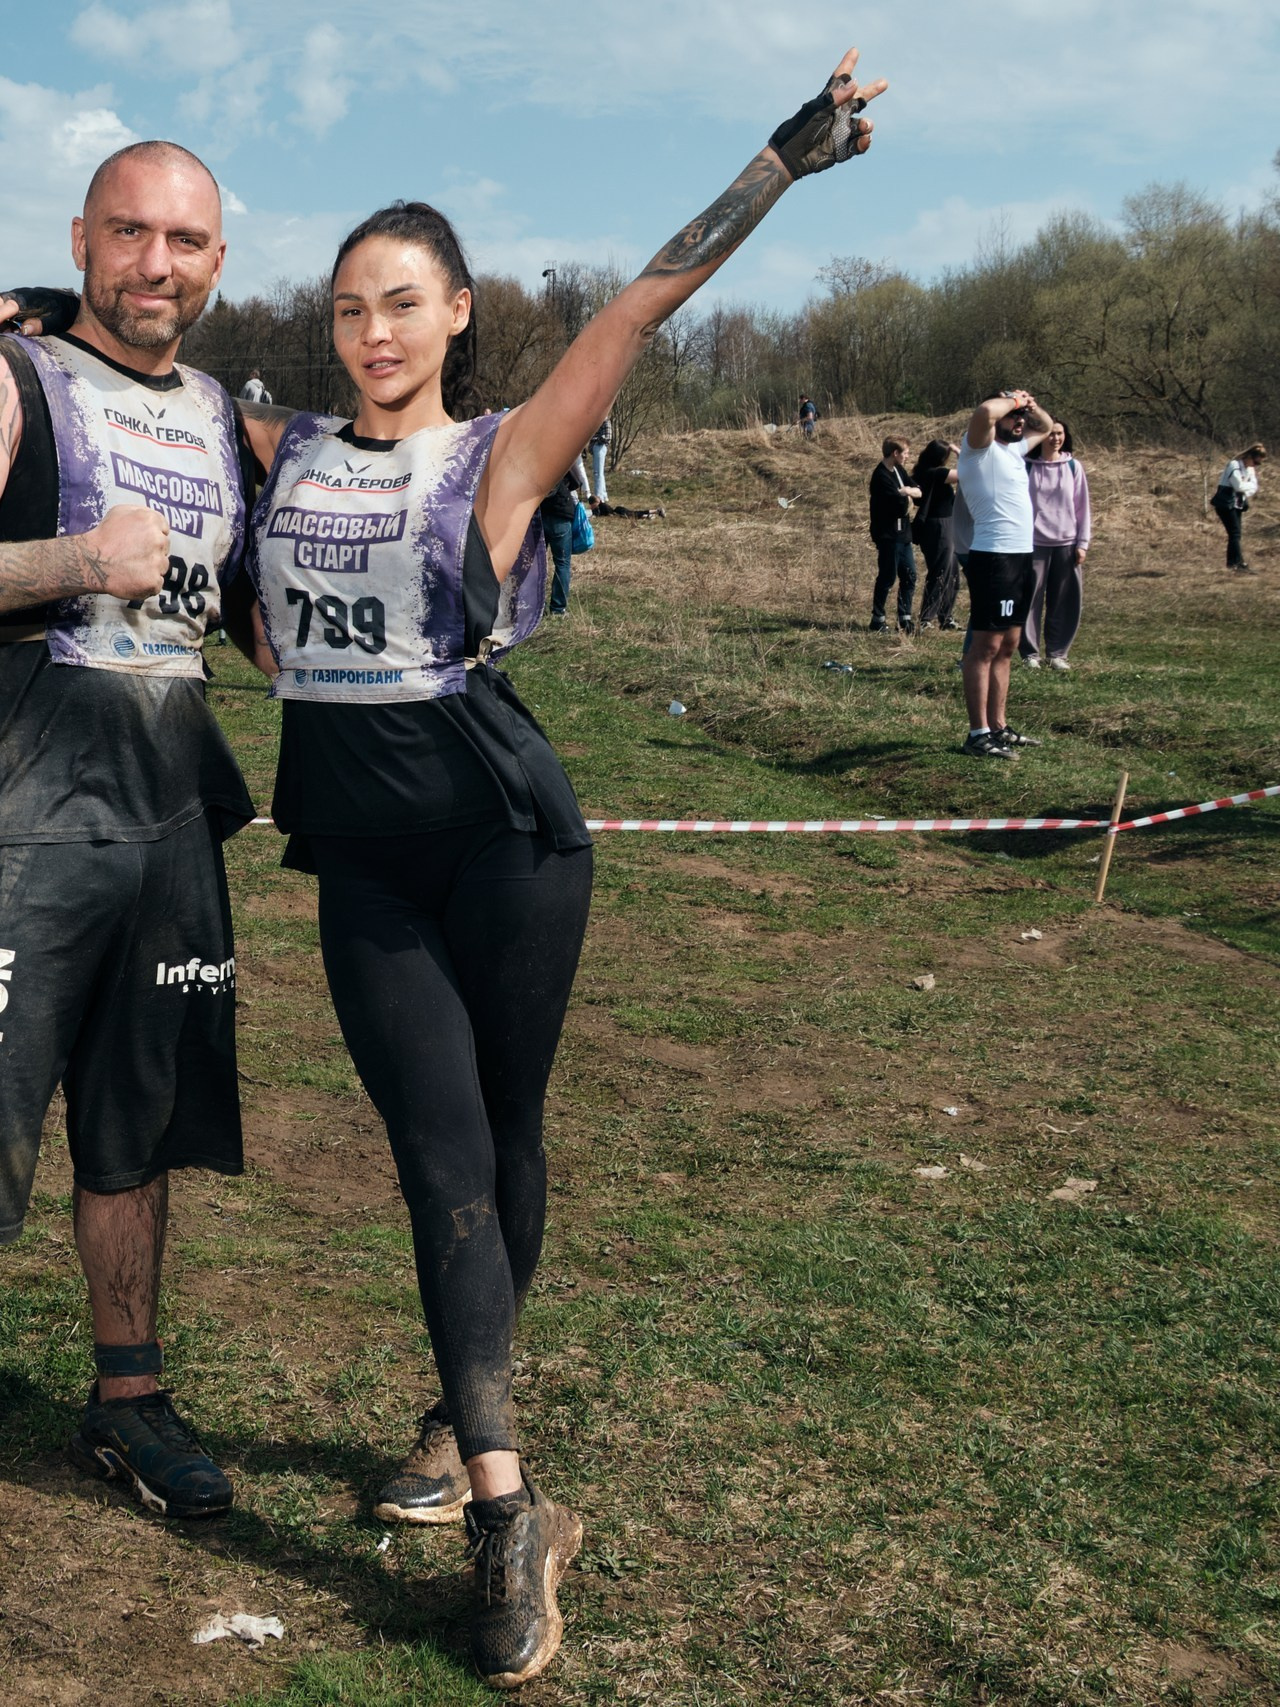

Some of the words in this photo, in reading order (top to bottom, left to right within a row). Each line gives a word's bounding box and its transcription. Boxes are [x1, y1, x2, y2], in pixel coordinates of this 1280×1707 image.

[104, 408, 154, 436] ГОНКА
[156, 427, 206, 449] ГЕРОЕВ
[116, 458, 220, 511] МАССОВЫЙ
[297, 469, 342, 488] ОНКА
[348, 472, 412, 489] ГЕРОЕВ
[272, 511, 401, 540] МАССОВЫЙ
[298, 541, 364, 570] СТАРТ
[127, 554, 209, 619] 98
[285, 588, 387, 655] 799
[1000, 599, 1014, 617] 10
[312, 669, 404, 685] ГАЗПРОМБАНК
[182, 979, 235, 995] STYLE
